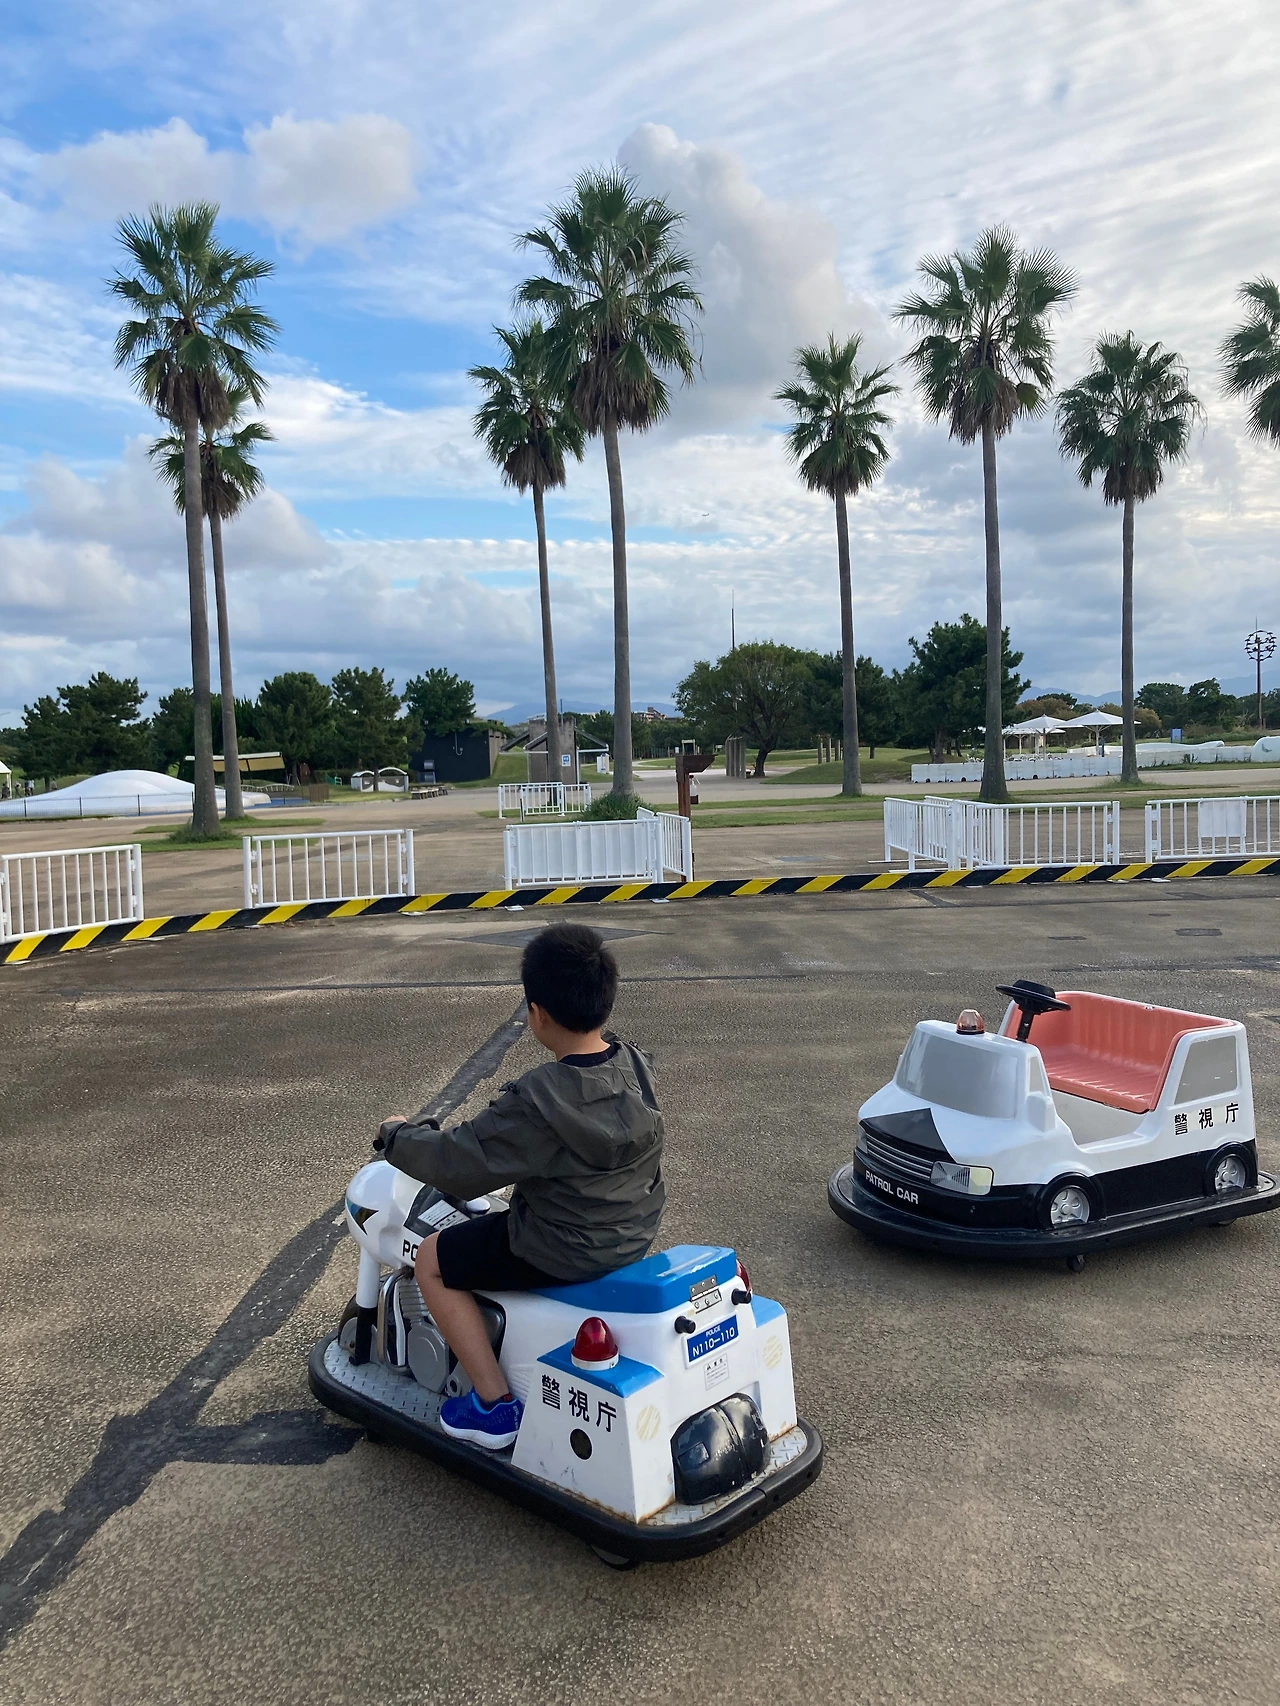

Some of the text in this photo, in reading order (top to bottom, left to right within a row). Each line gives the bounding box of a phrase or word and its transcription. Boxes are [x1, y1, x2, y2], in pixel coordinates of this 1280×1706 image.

[1174, 1102, 1240, 1136] 警視庁
[865, 1169, 919, 1205] PATROL CAR
[692, 1326, 735, 1357] N110-110
[705, 1325, 721, 1337] POLICE
[541, 1374, 617, 1433] 警視庁
